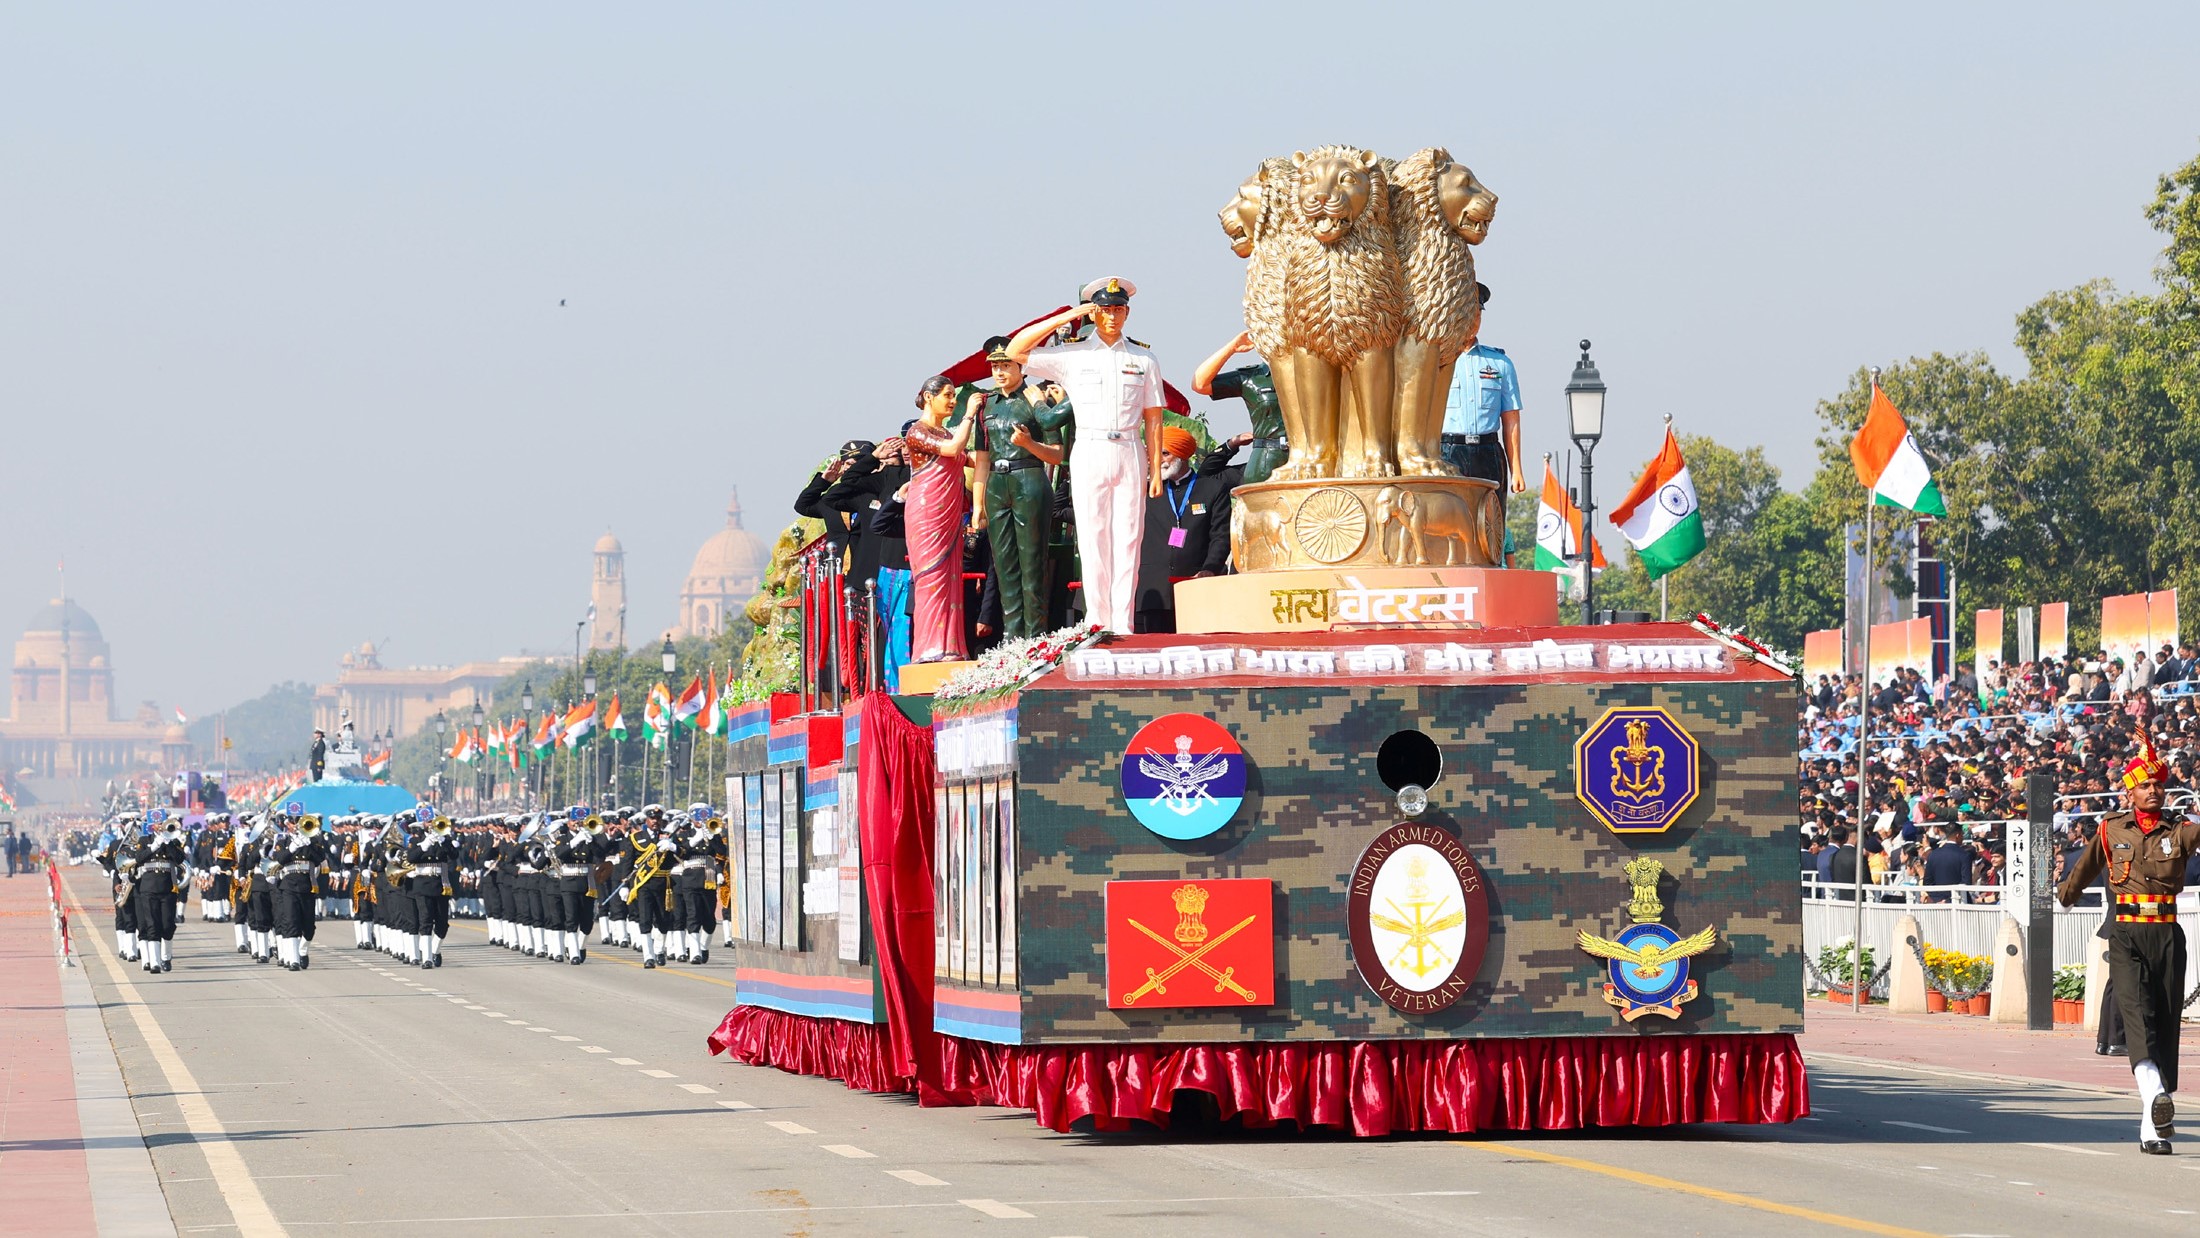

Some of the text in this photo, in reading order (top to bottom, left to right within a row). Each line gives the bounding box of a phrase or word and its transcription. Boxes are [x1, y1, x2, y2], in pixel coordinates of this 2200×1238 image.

[1336, 576, 1479, 623] वेटरन्स
[1069, 645, 1236, 676] विकसित
[1239, 647, 1336, 673] भारत
[1344, 644, 1406, 673] की
[1607, 644, 1724, 670] अग्रसर
[1354, 827, 1480, 896] INDIAN ARMED FORCES
[1379, 975, 1466, 1010] VETERAN
